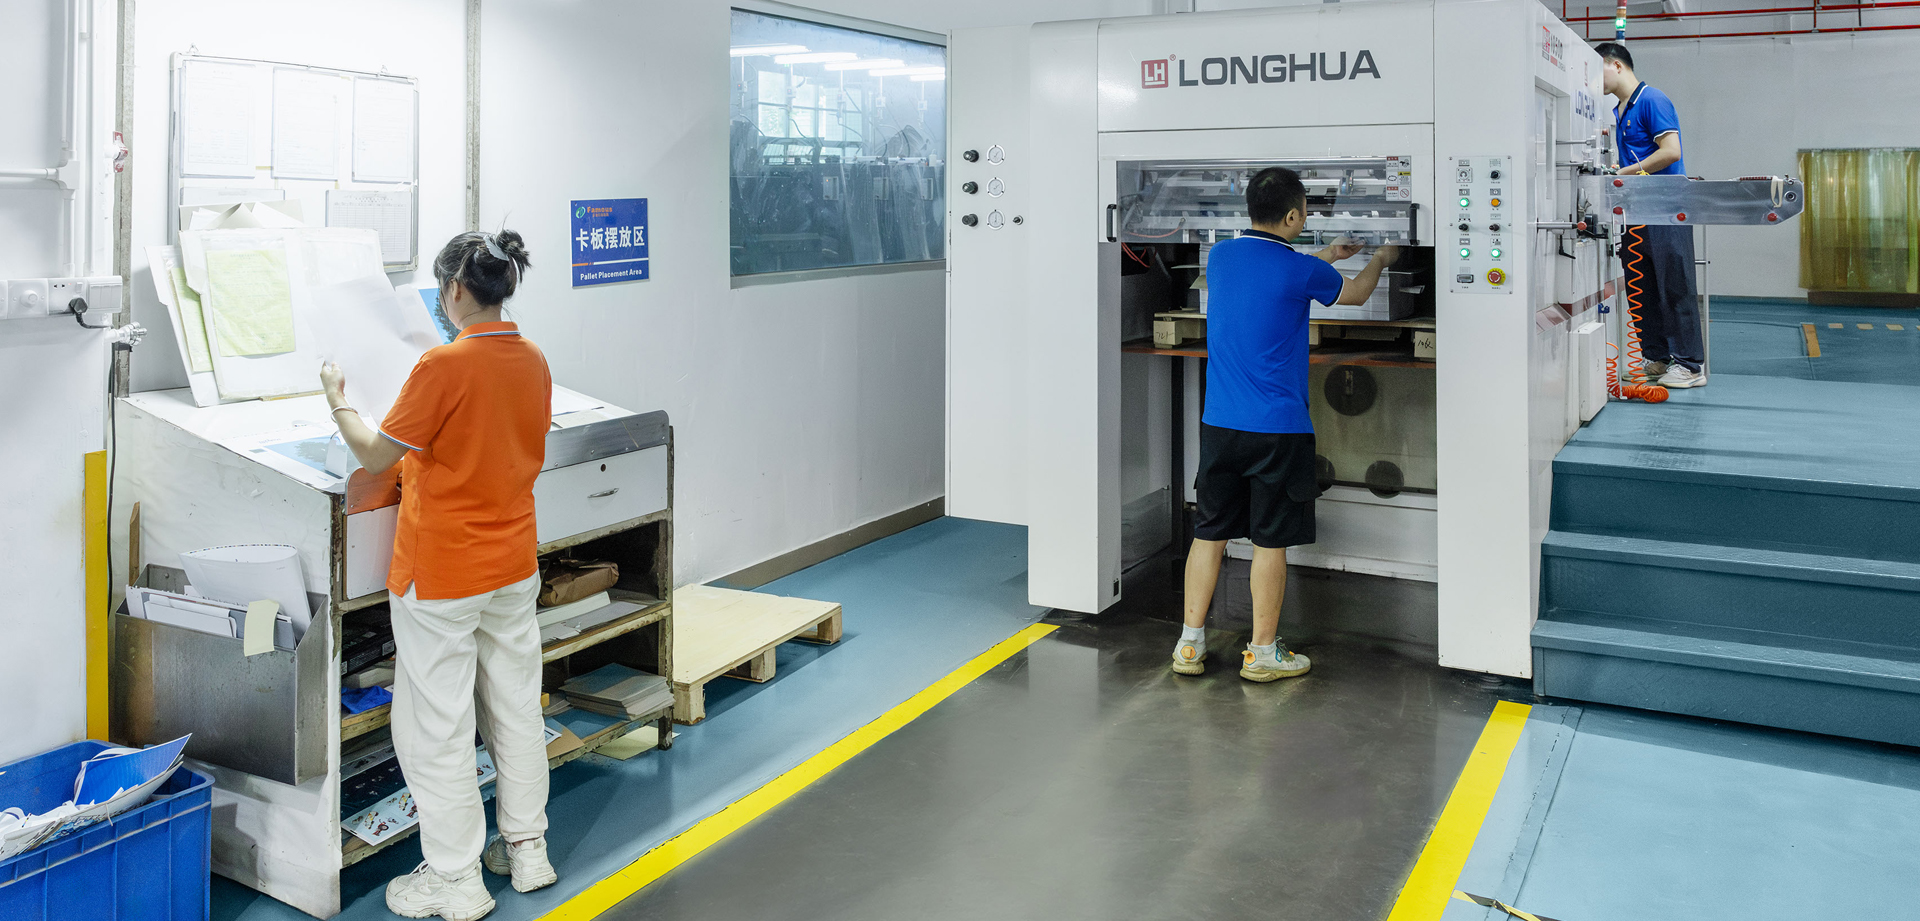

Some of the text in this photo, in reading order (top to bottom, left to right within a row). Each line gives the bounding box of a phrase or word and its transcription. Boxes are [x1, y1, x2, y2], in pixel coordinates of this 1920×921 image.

[1143, 49, 1382, 87] LH LONGHUA
[575, 225, 645, 252] 卡板摆放区
[580, 268, 642, 281] Pallet Placement Area
